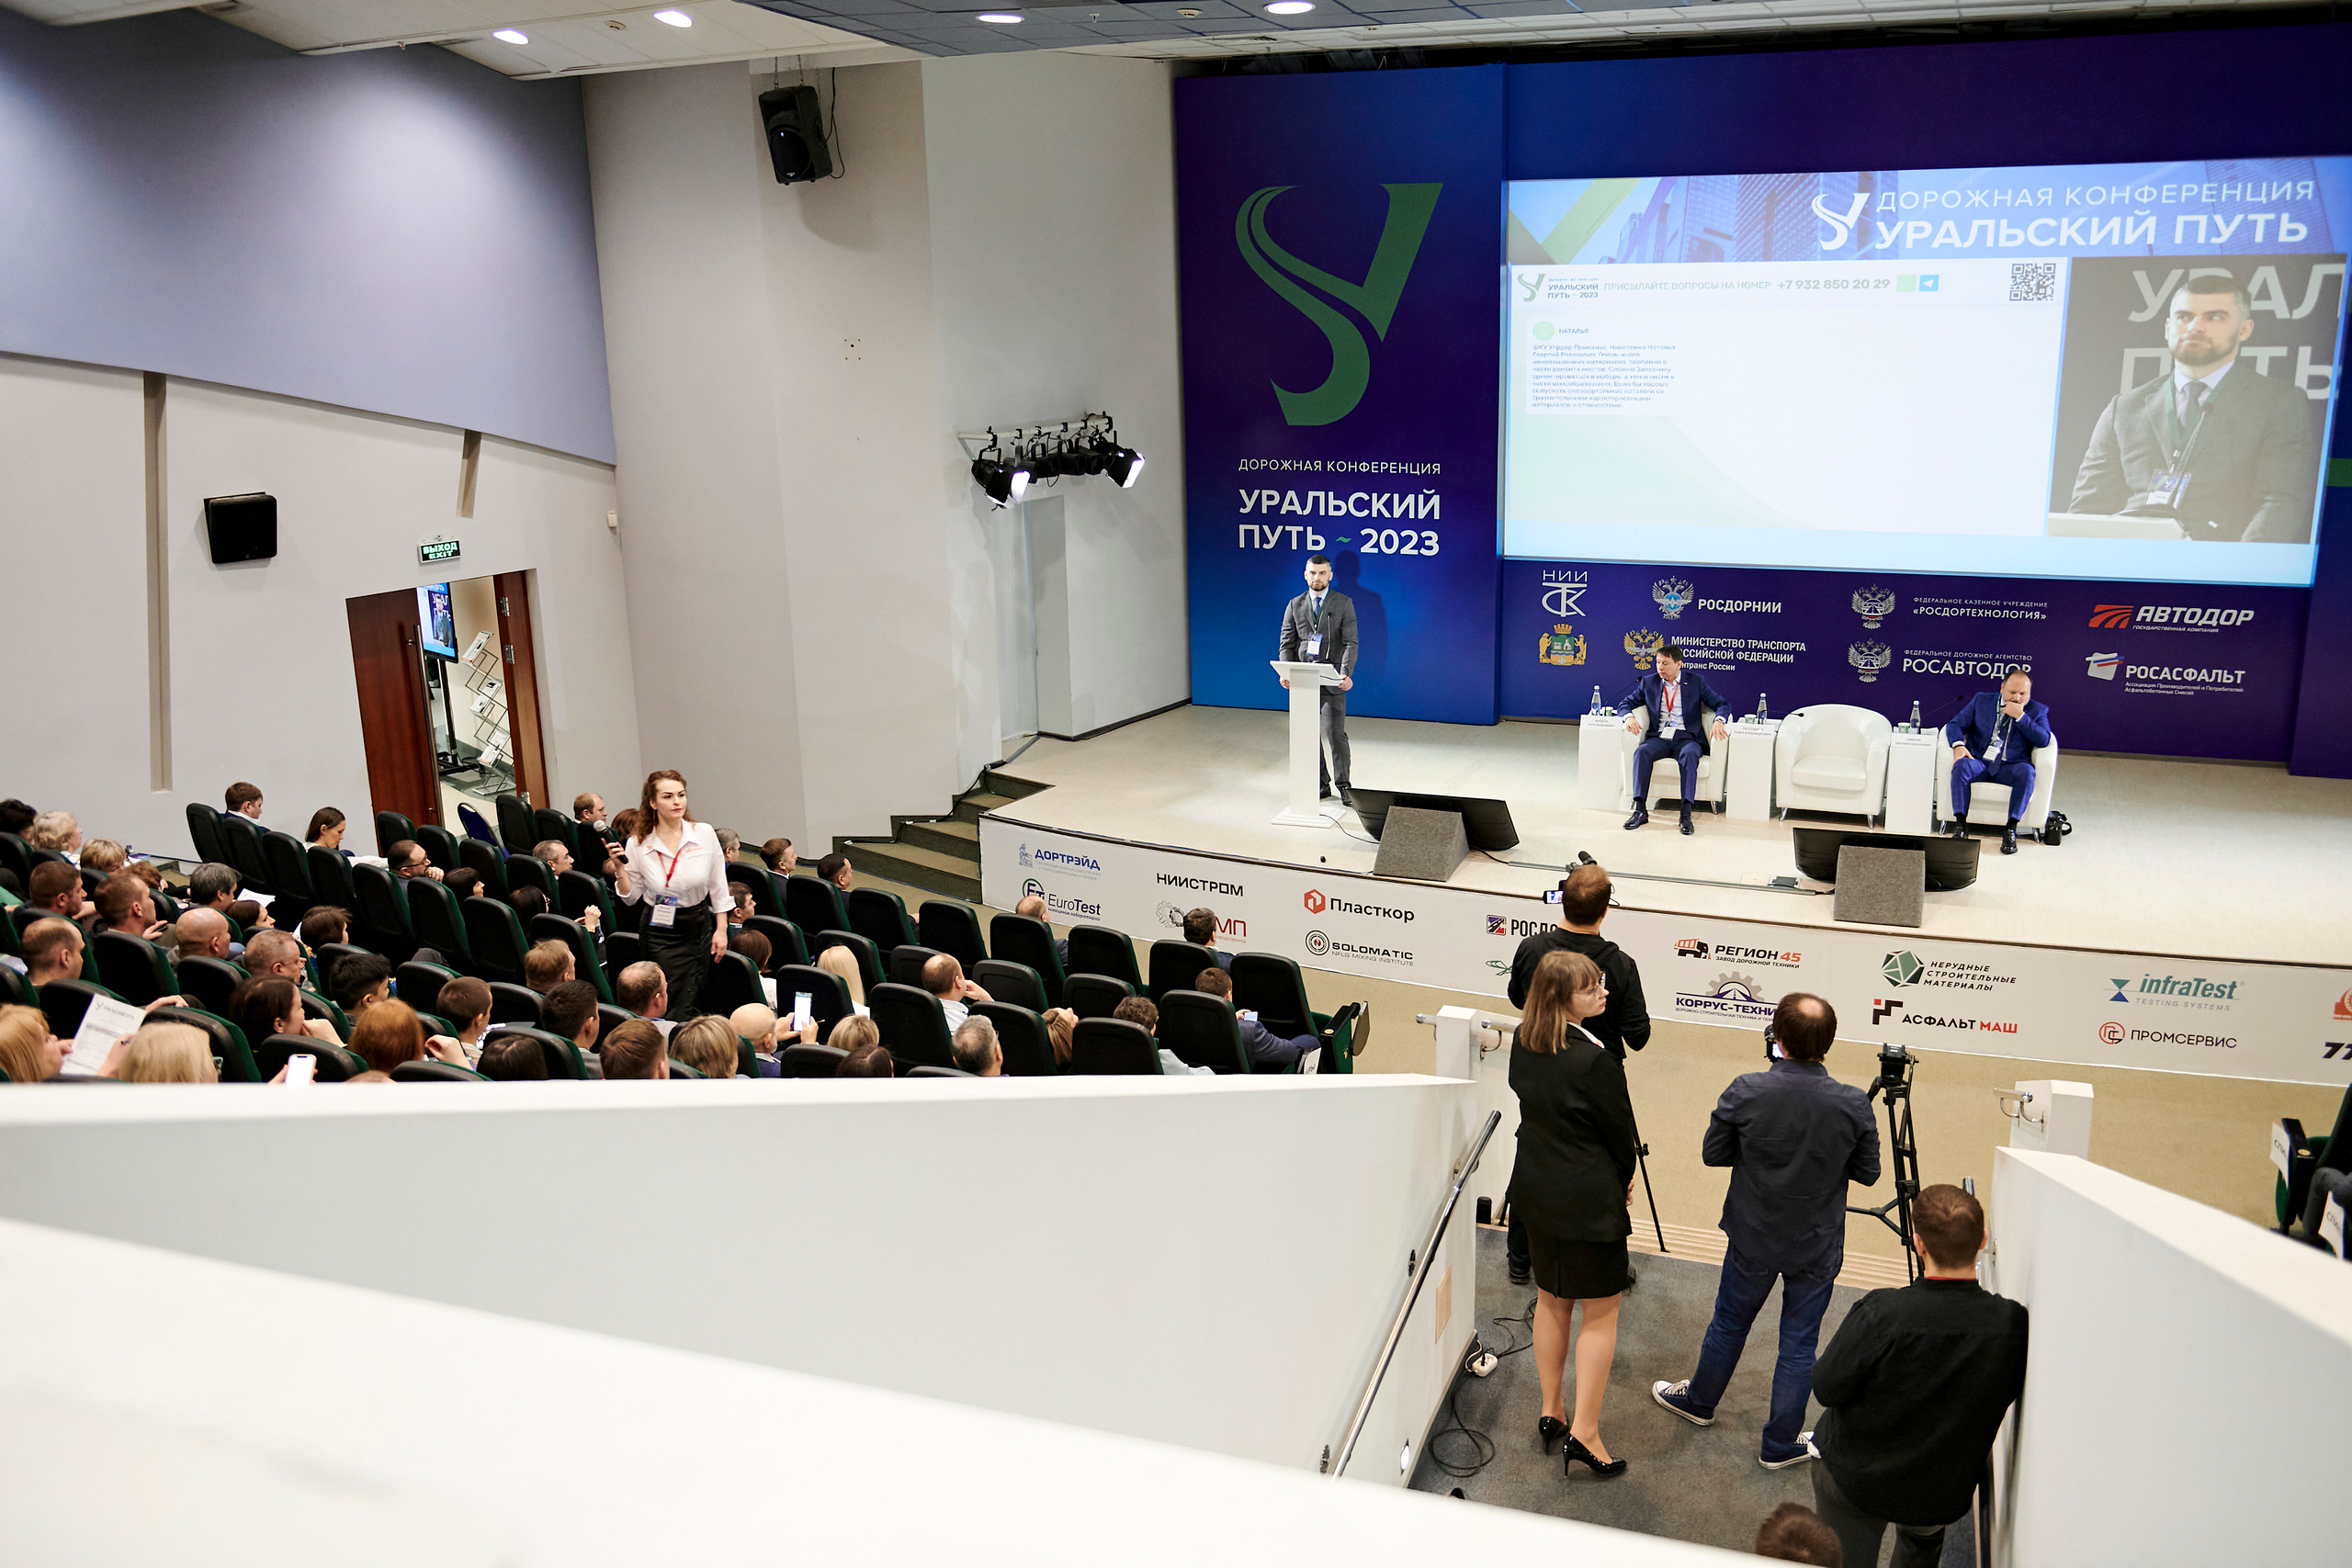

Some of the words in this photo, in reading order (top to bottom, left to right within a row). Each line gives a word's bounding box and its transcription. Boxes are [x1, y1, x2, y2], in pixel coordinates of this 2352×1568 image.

[1876, 186, 2053, 213] ДОРОЖНАЯ
[2065, 179, 2314, 208] КОНФЕРЕНЦИЯ
[1874, 210, 2156, 251] УРАЛЬСКИЙ
[2173, 214, 2308, 246] ПУТЬ
[1548, 282, 1599, 291] УРАЛЬСКИЙ
[1604, 280, 1669, 291] ПРИСЫЛАЙТЕ
[1671, 280, 1719, 290] ВОПРОСЫ
[1721, 280, 1736, 290] НА
[1736, 279, 1771, 290] НОМЕР
[1777, 278, 1792, 290] +7
[1794, 278, 1821, 290] 932
[1824, 278, 1850, 289] 850
[1852, 278, 1871, 289] 20
[1872, 277, 1891, 289] 29
[1547, 291, 1570, 299] ПУТЬ
[2120, 345, 2337, 400] ПТЬ
[1238, 458, 1322, 472] ДОРОЖНАЯ
[1327, 460, 1442, 476] КОНФЕРЕНЦИЯ
[1238, 488, 1441, 521] УРАЛЬСКИЙ
[423, 542, 458, 555] ВЫХОД
[1238, 524, 1326, 551] ПУТЬ
[1360, 527, 1440, 557] 2023
[428, 550, 453, 559] EXIT
[1543, 570, 1588, 582] НИИ
[1697, 598, 1782, 614] РОСДОРНИИ
[1913, 596, 1962, 604] ФЕДЕРАЛЬНОЕ
[1964, 598, 2001, 606] КАЗЕННОЕ
[2002, 600, 2048, 608] УЧРЕЖДЕНИЕ
[1913, 606, 2047, 620] «РОСДОРТЕХНОЛОГИЯ»
[2135, 605, 2255, 626] АВТОДОР
[1670, 636, 1746, 649] МИНИСТЕРСТВО
[1747, 638, 1806, 651] ТРАНСПОРТА
[1680, 648, 1734, 660] ССИЙСКОЙ
[1736, 651, 1793, 664] ФЕДЕРАЦИИ
[1904, 649, 1951, 658] ФЕДЕРАЛЬНОЕ
[1953, 651, 1993, 660] ДОРОЖНОЕ
[1995, 653, 2032, 661] АГЕНТСТВО
[1681, 661, 1707, 671] нтранс
[1708, 662, 1736, 671] России
[1902, 658, 2031, 680] РОСАВТОДОР
[2125, 665, 2245, 684] РОСАСФАЛЬТ
[1035, 849, 1101, 871] ДОРТРЭЙД
[1156, 872, 1244, 897] НИИСТРОМ
[1047, 893, 1102, 916] EuroTest
[1330, 897, 1415, 924] Пласткор
[1215, 916, 1247, 938] МП
[1331, 941, 1414, 960] SOLOMATIC
[1714, 944, 1779, 961] РЕГИОН
[1780, 952, 1802, 963] 45
[1351, 953, 1377, 962] MIXING
[1378, 957, 1414, 966] INSTITUTE
[1736, 958, 1770, 966] ДОРОЖНОЙ
[1930, 961, 1991, 973] НЕРУДНЫЕ
[1923, 978, 1994, 991] МАТЕРИАЛЫ
[1927, 970, 2017, 984] СТРОИТЕЛЬНЫЕ
[2138, 974, 2238, 1000] infraTest
[1676, 998, 1778, 1016] КОРРУС-ТЕХНИ
[2135, 998, 2179, 1008] TESTING
[2183, 1000, 2231, 1011] SYSTEMS
[1699, 1010, 1736, 1019] СТРОИТЕЛЬНАЯ
[1902, 1013, 1976, 1030] АСФАЛЬТ
[1979, 1021, 2018, 1033] МАШ
[2131, 1029, 2237, 1048] ПРОМСЕРВИС
